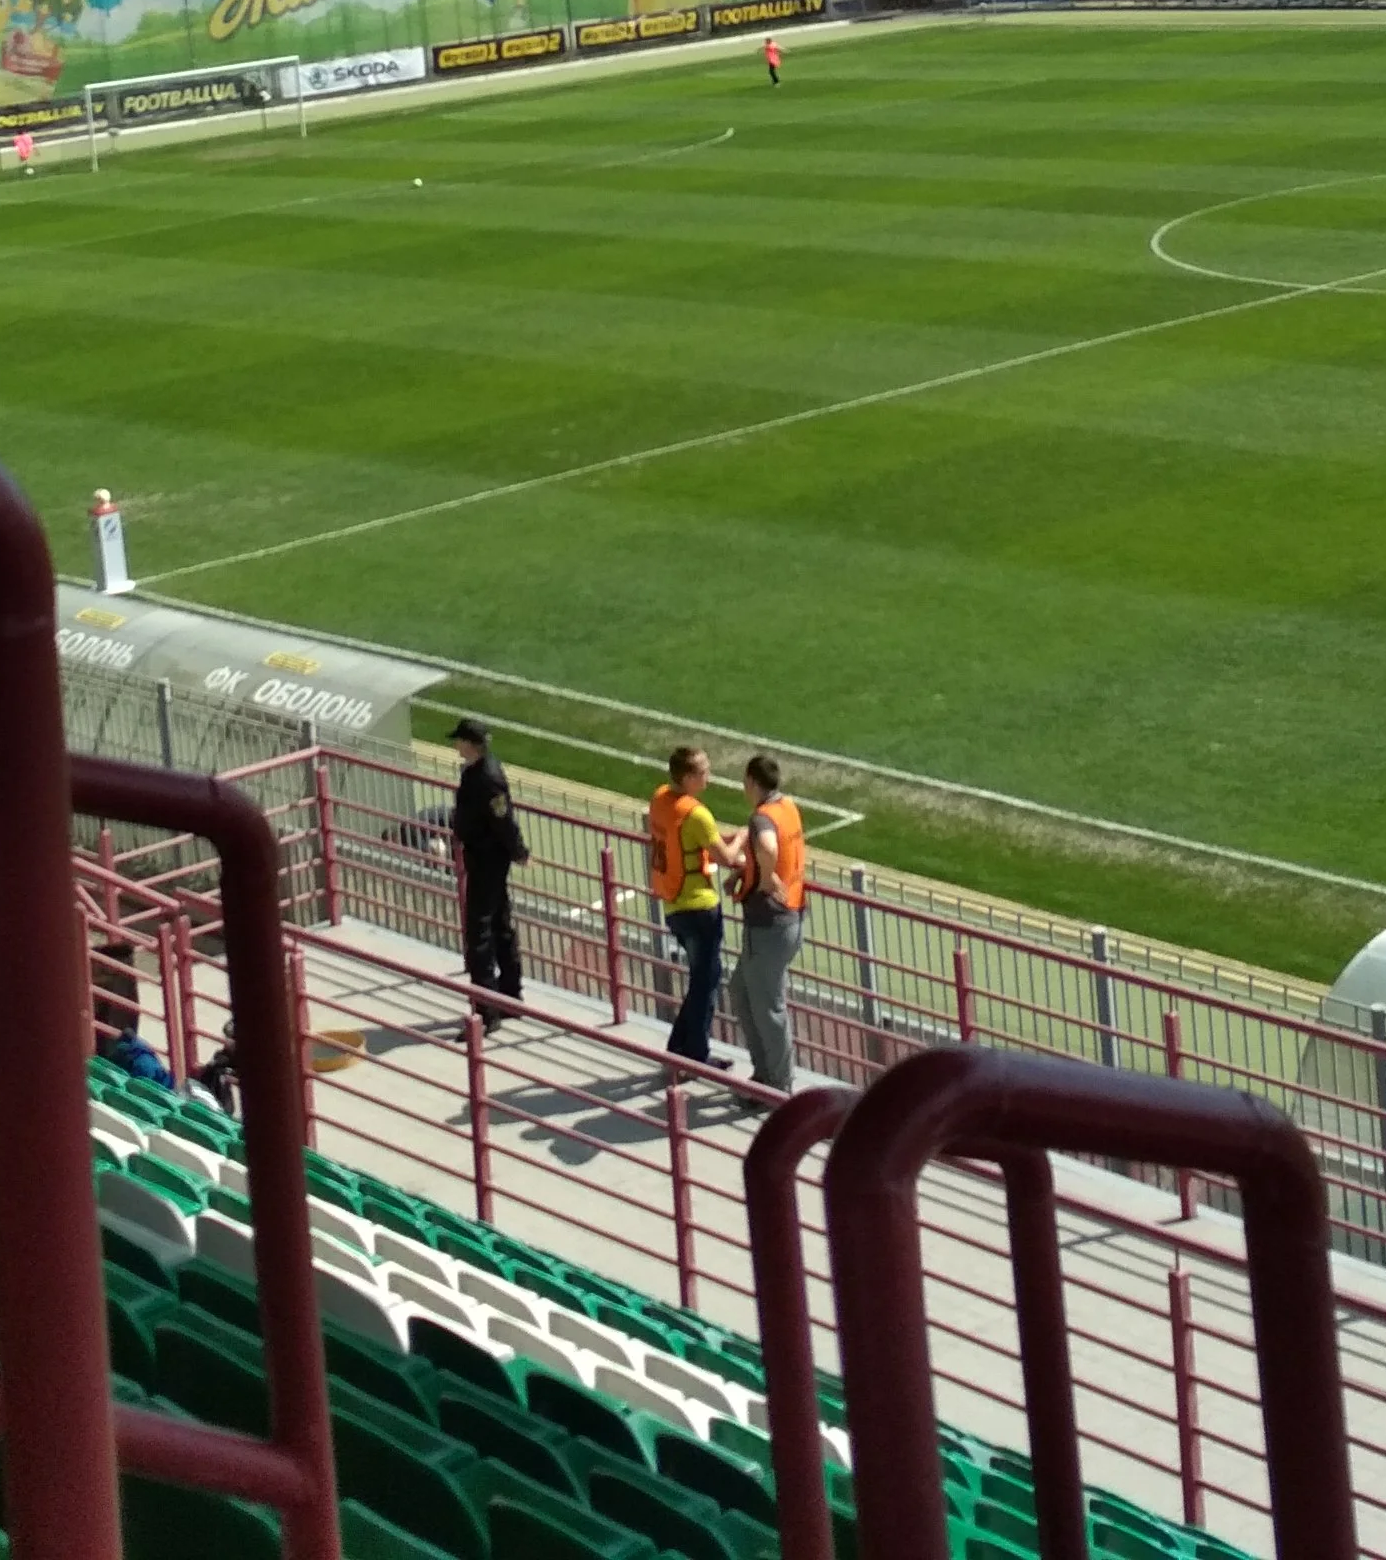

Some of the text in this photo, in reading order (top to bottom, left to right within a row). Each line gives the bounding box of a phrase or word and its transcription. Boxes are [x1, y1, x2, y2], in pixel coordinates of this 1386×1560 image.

[56, 628, 135, 668] БОЛОНЬ
[203, 665, 373, 730] ФК ОБОЛОНЬ
